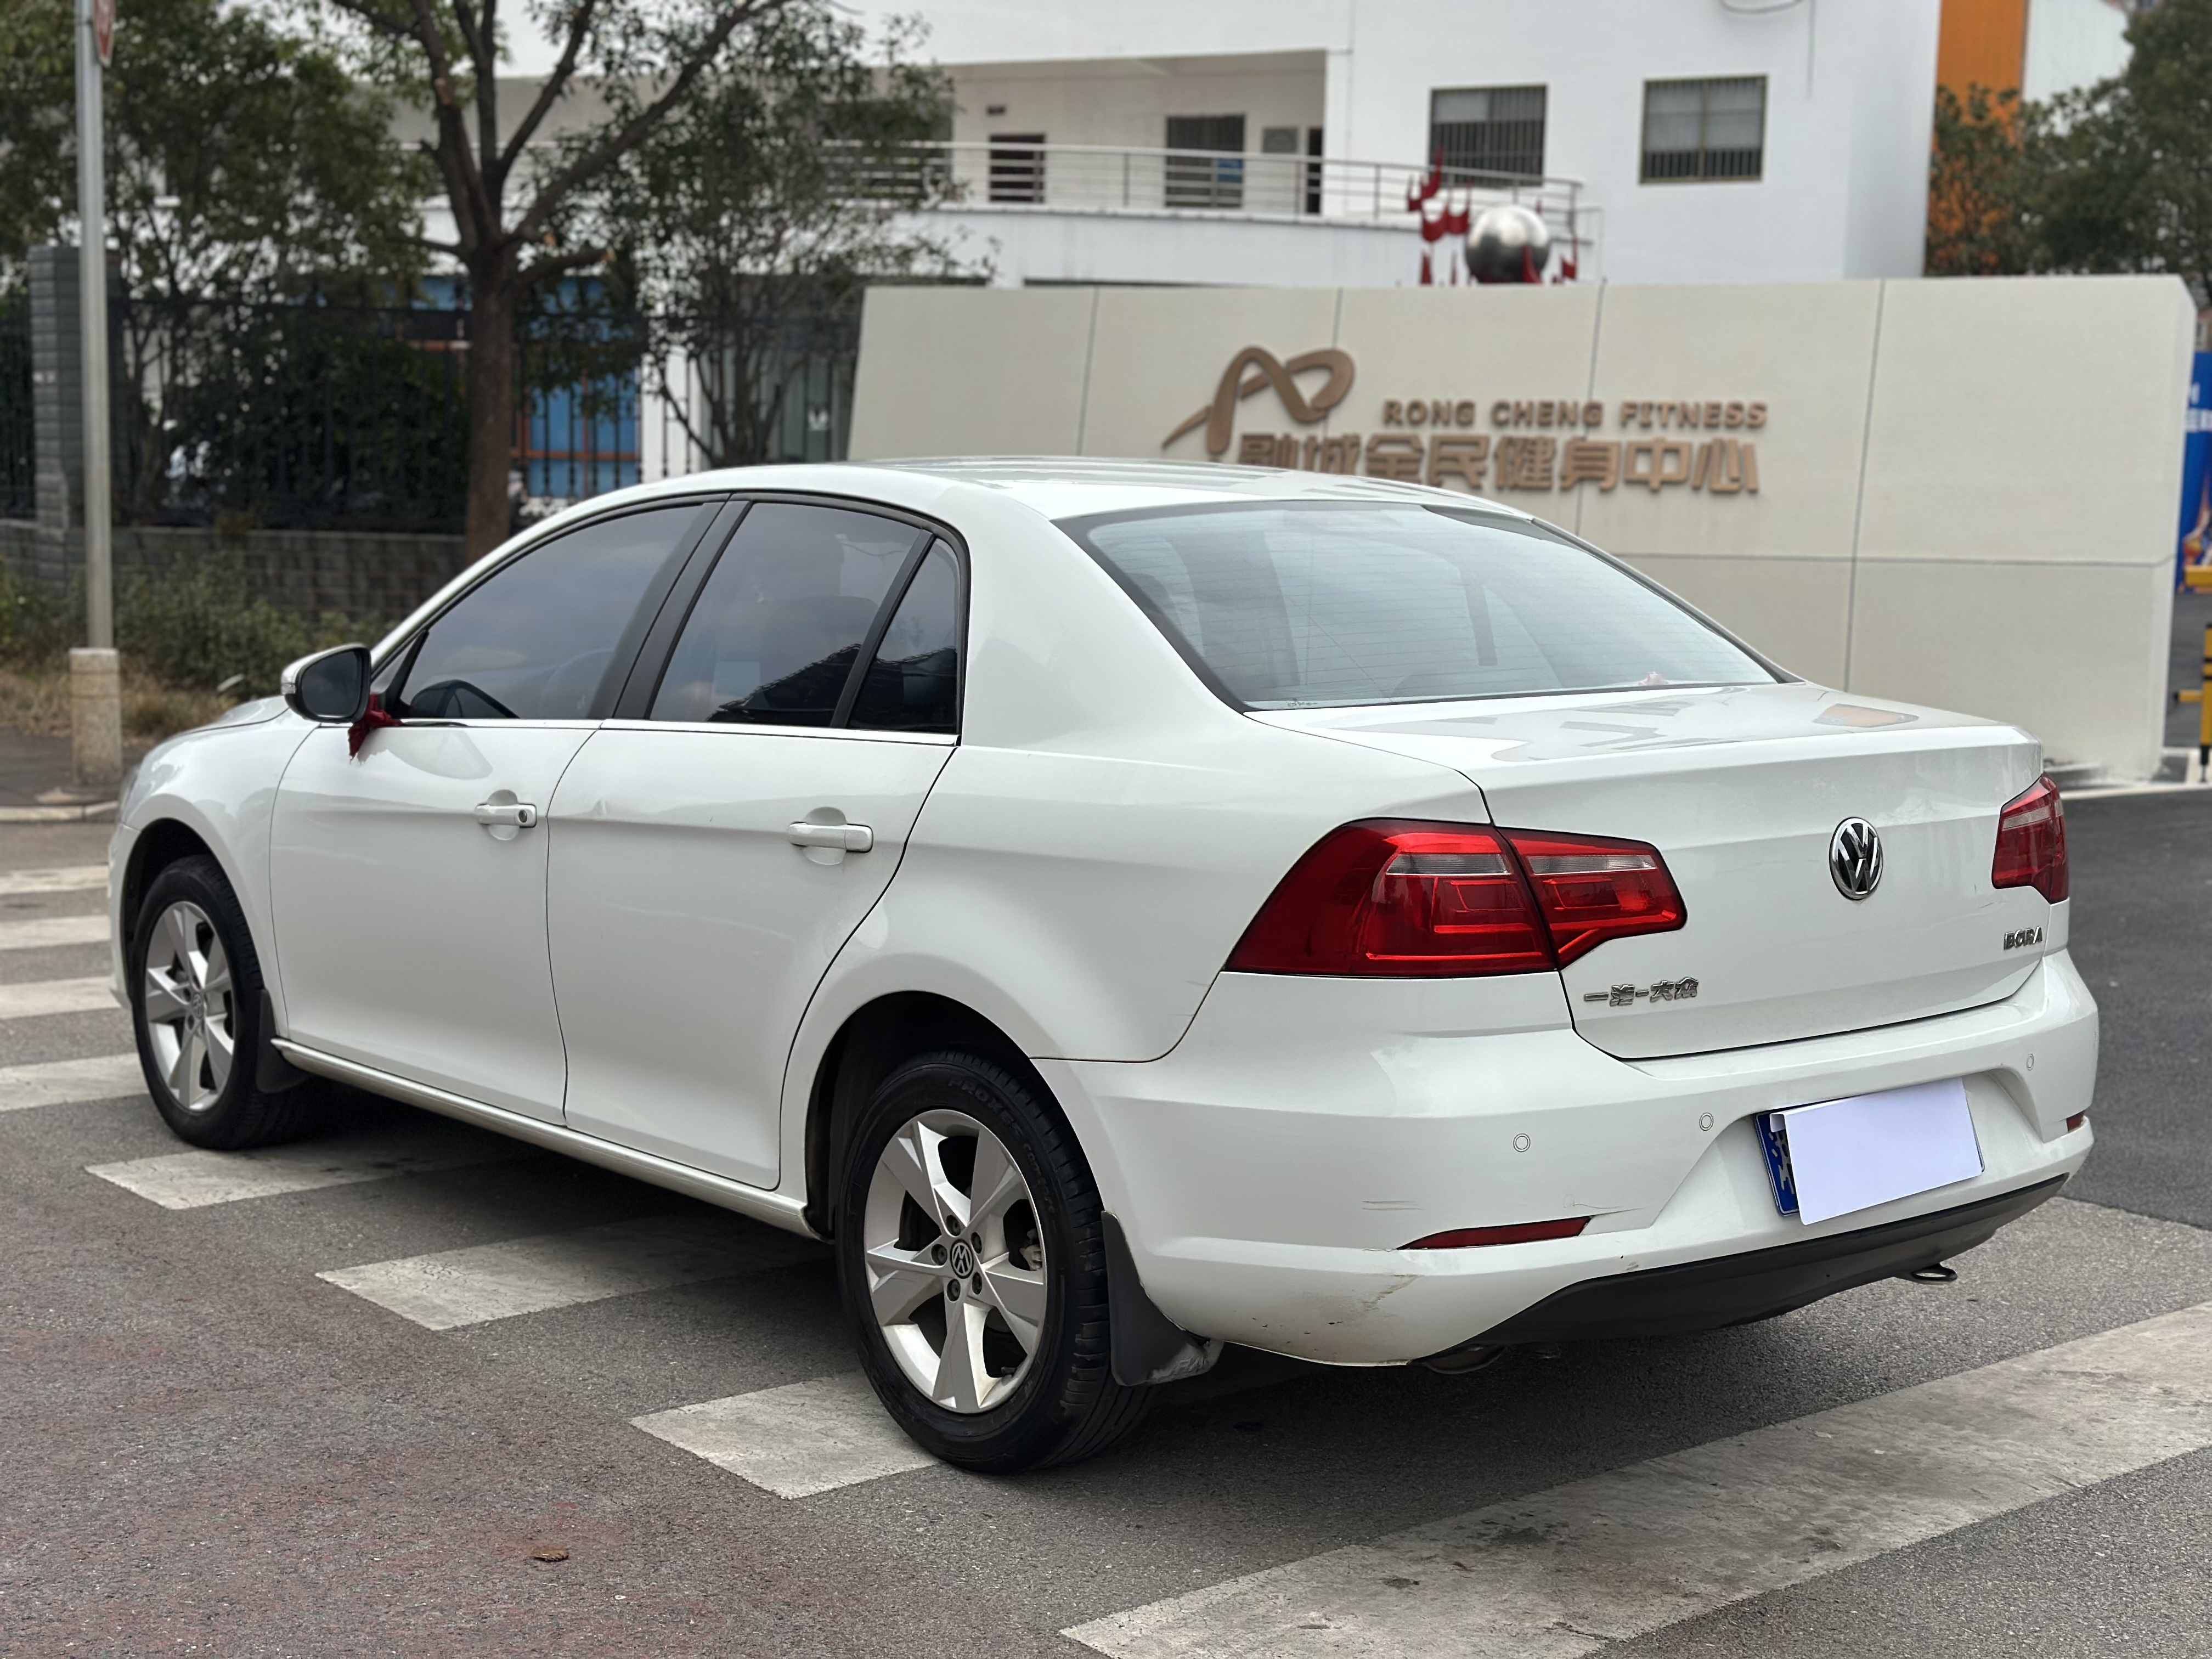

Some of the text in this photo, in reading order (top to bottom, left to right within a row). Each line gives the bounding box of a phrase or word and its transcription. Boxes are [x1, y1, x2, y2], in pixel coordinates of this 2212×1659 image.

[1383, 399, 1768, 428] RONG CHENG FITNESS
[2004, 926, 2042, 950] BORA
